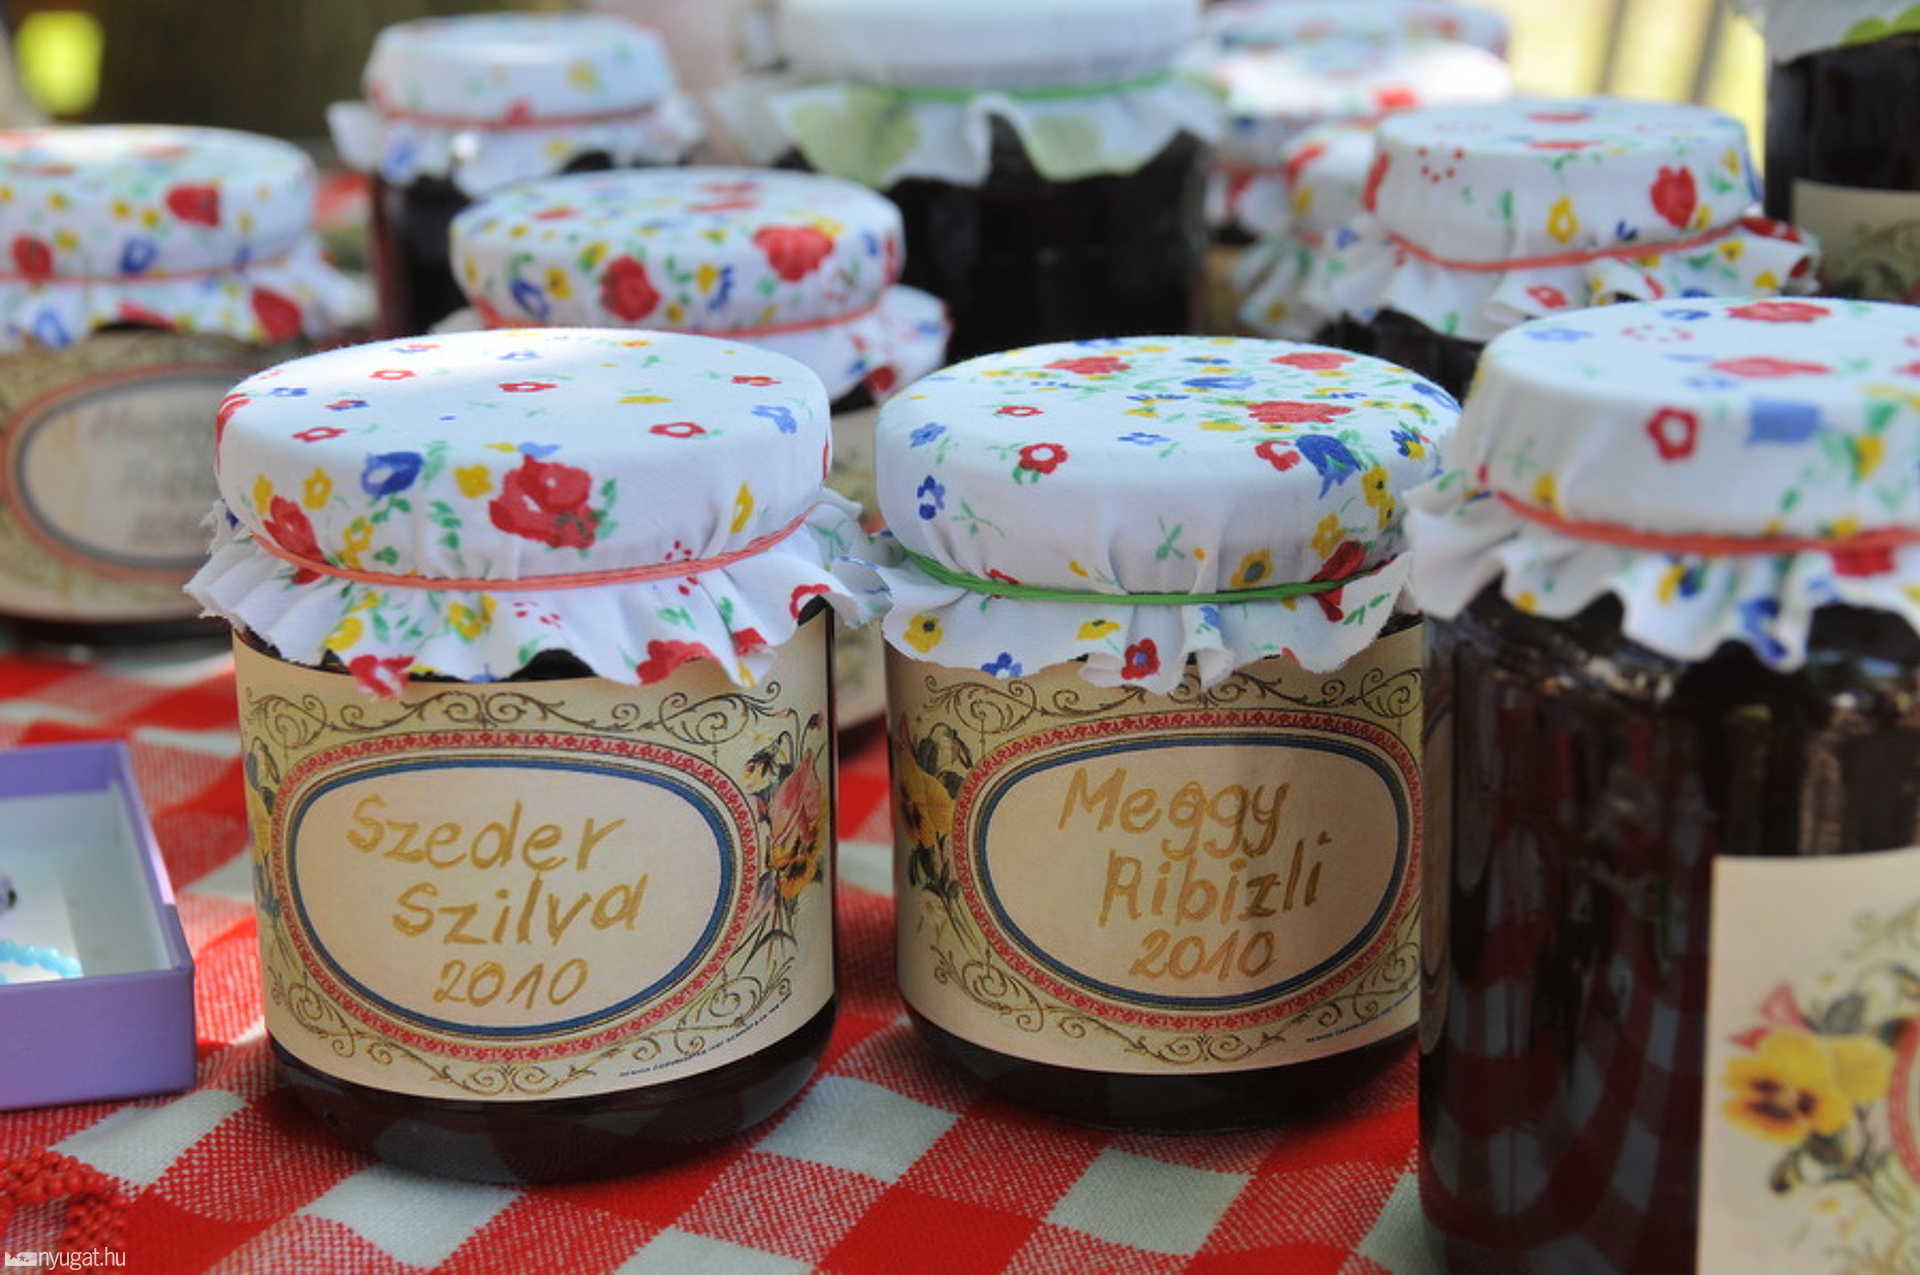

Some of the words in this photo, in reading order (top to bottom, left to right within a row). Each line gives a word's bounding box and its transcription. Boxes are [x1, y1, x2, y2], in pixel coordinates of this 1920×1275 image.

[346, 793, 626, 871] Szeder
[1058, 767, 1289, 860] Meggy
[392, 873, 648, 944] Szilva
[1098, 831, 1332, 928] Ribizli
[433, 958, 588, 1009] 2010
[1129, 929, 1277, 981] 2010
